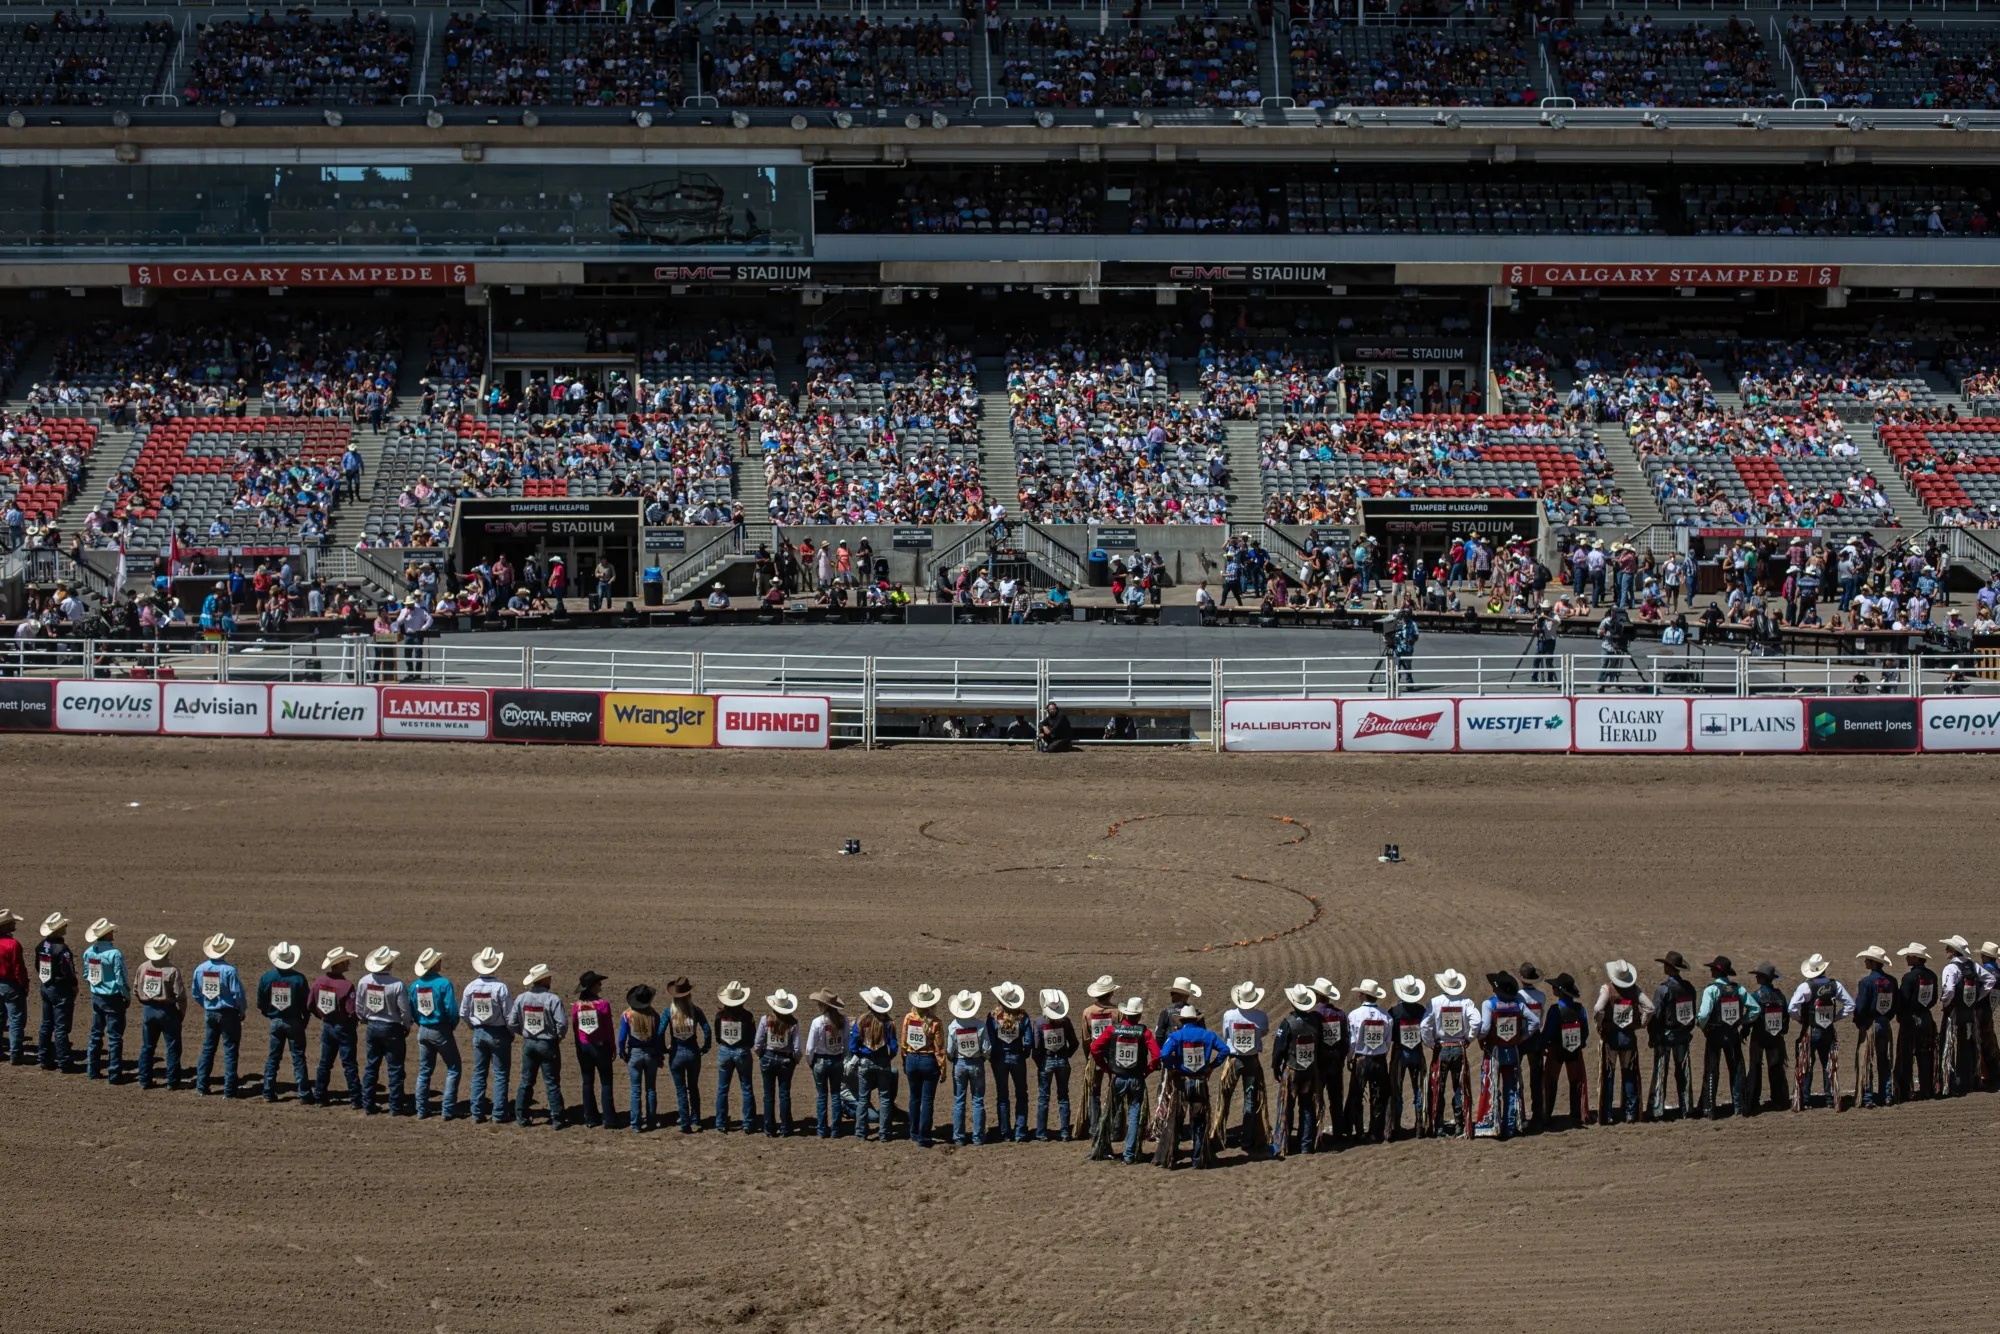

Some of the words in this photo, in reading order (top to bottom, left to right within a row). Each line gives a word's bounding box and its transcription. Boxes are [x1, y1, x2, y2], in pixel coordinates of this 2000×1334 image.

[173, 268, 290, 282] CALGARY
[300, 267, 432, 282] STAMPEDE
[654, 266, 731, 280] GMC
[737, 266, 811, 280] STADIUM
[1170, 266, 1246, 280] GMC
[1252, 266, 1326, 280] STADIUM
[1545, 268, 1660, 282] CALGARY
[1669, 268, 1799, 283] STAMPEDE
[1355, 348, 1409, 359] GMC
[1412, 348, 1463, 359] STADIUM
[510, 504, 548, 512] STAMPEDE
[549, 503, 590, 512] #LIKEAPRO
[1410, 504, 1447, 512] STAMPEDE
[1448, 504, 1488, 512] #LIKEAPRO
[484, 522, 548, 533] GMC
[551, 521, 615, 533] STADIUM
[1386, 521, 1447, 532] GMC
[1451, 521, 1514, 533] STADIUM
[20, 700, 47, 712] Jones
[173, 697, 257, 715] Advisian
[281, 700, 364, 721] Nutrien
[389, 699, 480, 717] LAMMLE'S
[505, 709, 548, 721] PIVOTAL
[550, 711, 593, 722] ENERGY
[612, 704, 705, 734] Wrangler
[400, 720, 441, 728] WESTERN
[444, 721, 469, 729] WEAR
[519, 720, 572, 728] PARTNERS
[725, 711, 820, 733] BURNCO
[1230, 721, 1331, 730] HALLIBURTON
[1357, 716, 1437, 733] Budweiser
[1466, 716, 1544, 734] WESTJET
[1730, 716, 1796, 732] PLAINS
[1843, 719, 1883, 730] Bennett
[1885, 719, 1912, 733] Jones
[146, 983, 158, 991] 507
[275, 995, 288, 1003] 518
[321, 998, 333, 1006] 513
[369, 997, 382, 1005] 502
[420, 1000, 432, 1008] 501
[1879, 1000, 1890, 1008] 105
[1819, 1012, 1830, 1020] 114
[527, 1018, 541, 1026] 504
[581, 1018, 596, 1026] 606
[1445, 1019, 1459, 1027] 327
[1500, 1024, 1514, 1032] 304
[724, 1029, 738, 1037] 613
[910, 1033, 924, 1042] 602
[1323, 1029, 1338, 1037] 302
[1366, 1032, 1381, 1040] 326
[1404, 1031, 1418, 1040] 321
[829, 1037, 841, 1045] 618
[961, 1040, 975, 1049] 619
[1236, 1036, 1252, 1045] 322
[1119, 1050, 1134, 1058] 301
[1299, 1051, 1312, 1059] 324
[1187, 1055, 1202, 1063] 311
